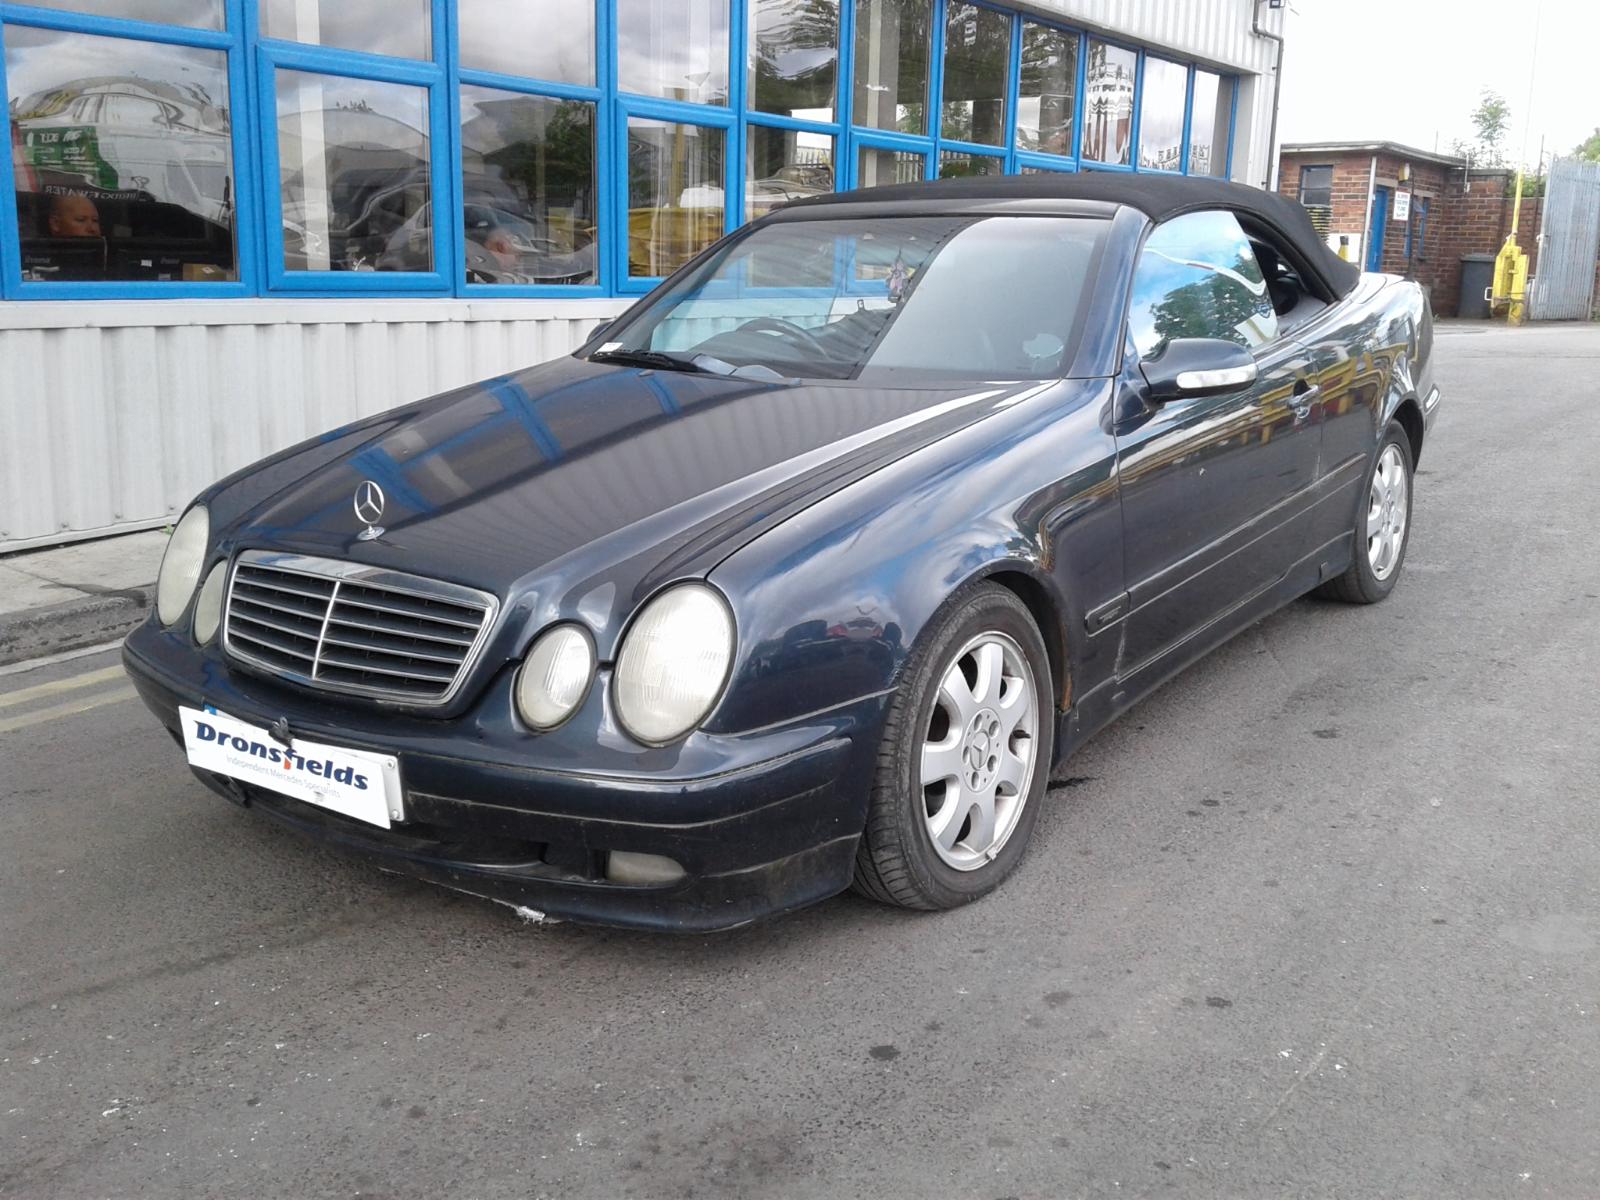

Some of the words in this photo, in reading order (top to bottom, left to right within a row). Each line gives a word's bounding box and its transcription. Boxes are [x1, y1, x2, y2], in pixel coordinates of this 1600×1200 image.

[194, 720, 368, 790] Dronsfields
[226, 754, 271, 776] Independent
[270, 767, 303, 787] Mercedes
